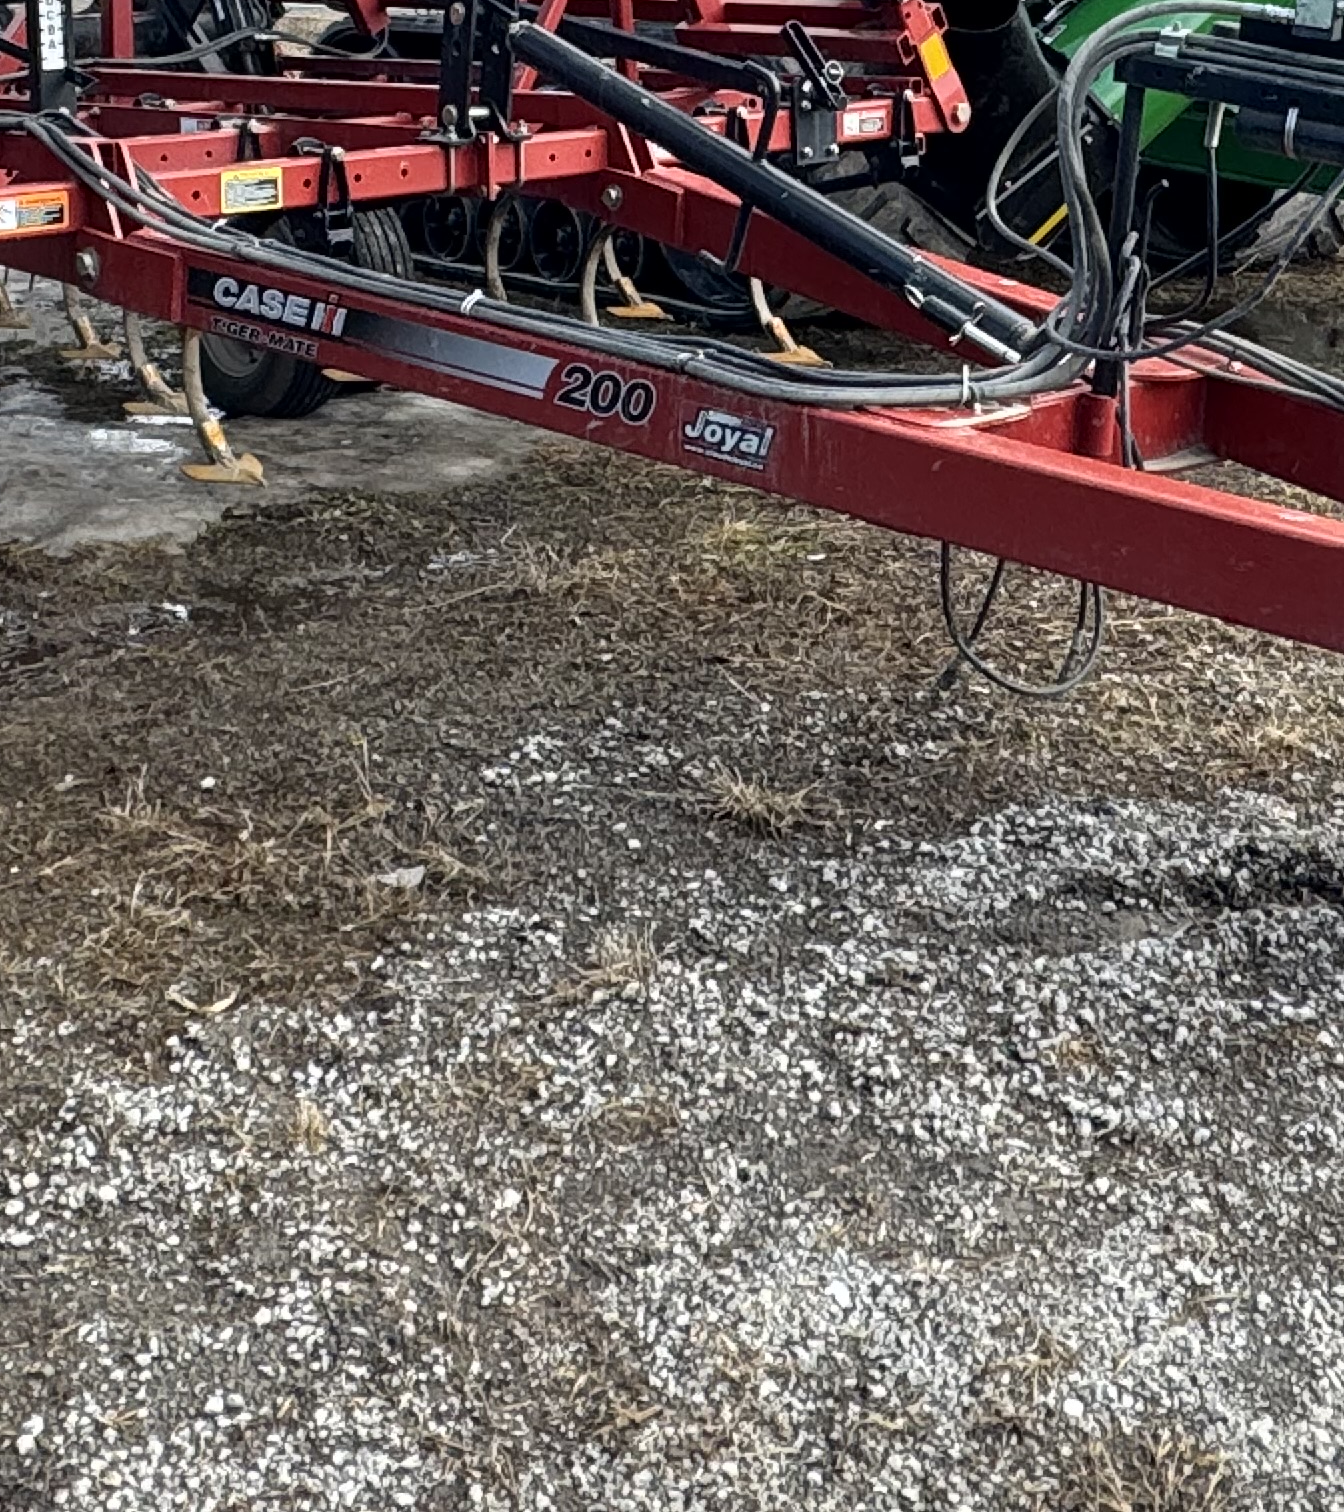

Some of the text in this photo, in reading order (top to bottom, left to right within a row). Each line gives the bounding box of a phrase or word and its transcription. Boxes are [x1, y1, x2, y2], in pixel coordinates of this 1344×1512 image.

[213, 277, 311, 327] CASE
[554, 363, 655, 426] 200
[684, 410, 775, 457] Joyal
